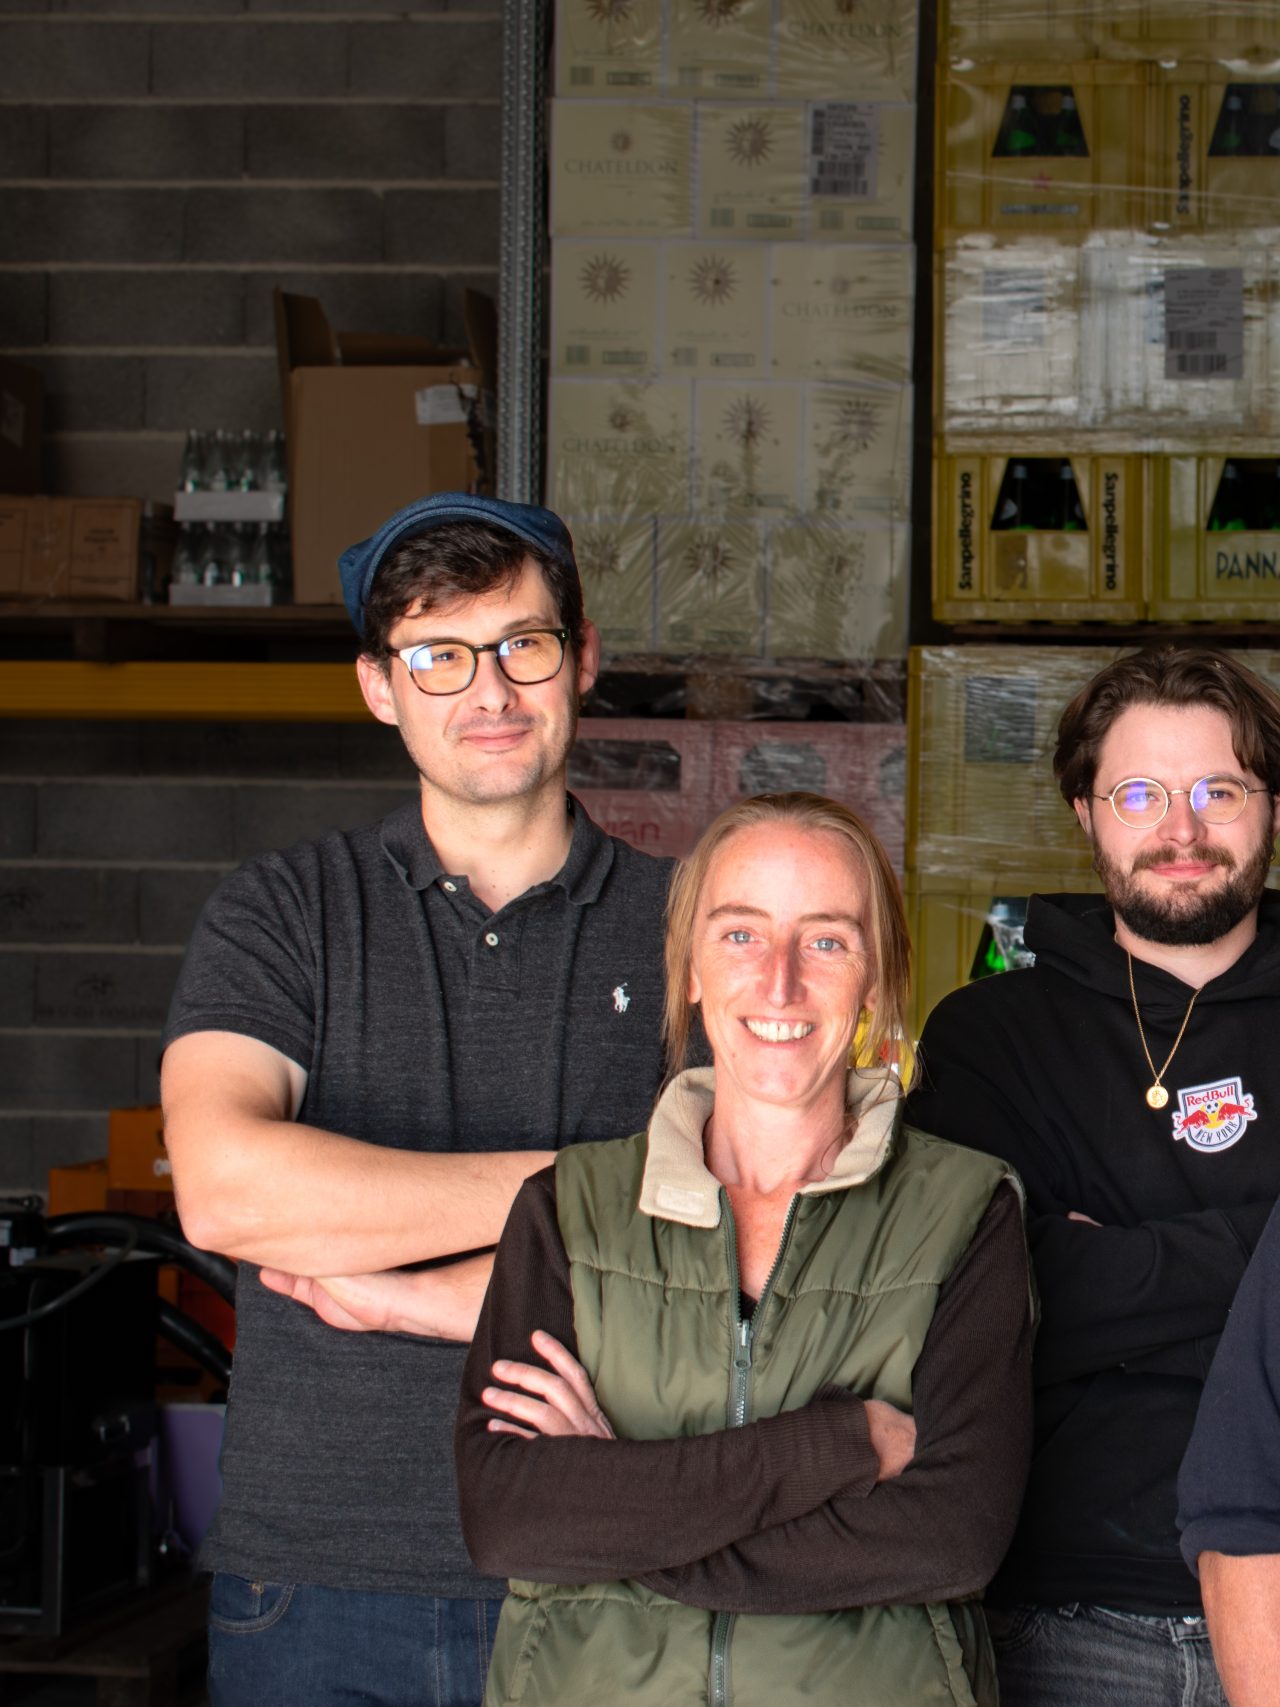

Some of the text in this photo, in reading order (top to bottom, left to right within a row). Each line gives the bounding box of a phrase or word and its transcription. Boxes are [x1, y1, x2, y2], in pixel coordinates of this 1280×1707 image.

[564, 158, 677, 176] CHATELDON
[957, 471, 975, 591] Sanpellegrino
[1101, 471, 1119, 592] Sanpellegrino
[1194, 1120, 1238, 1144] NEW YORK
